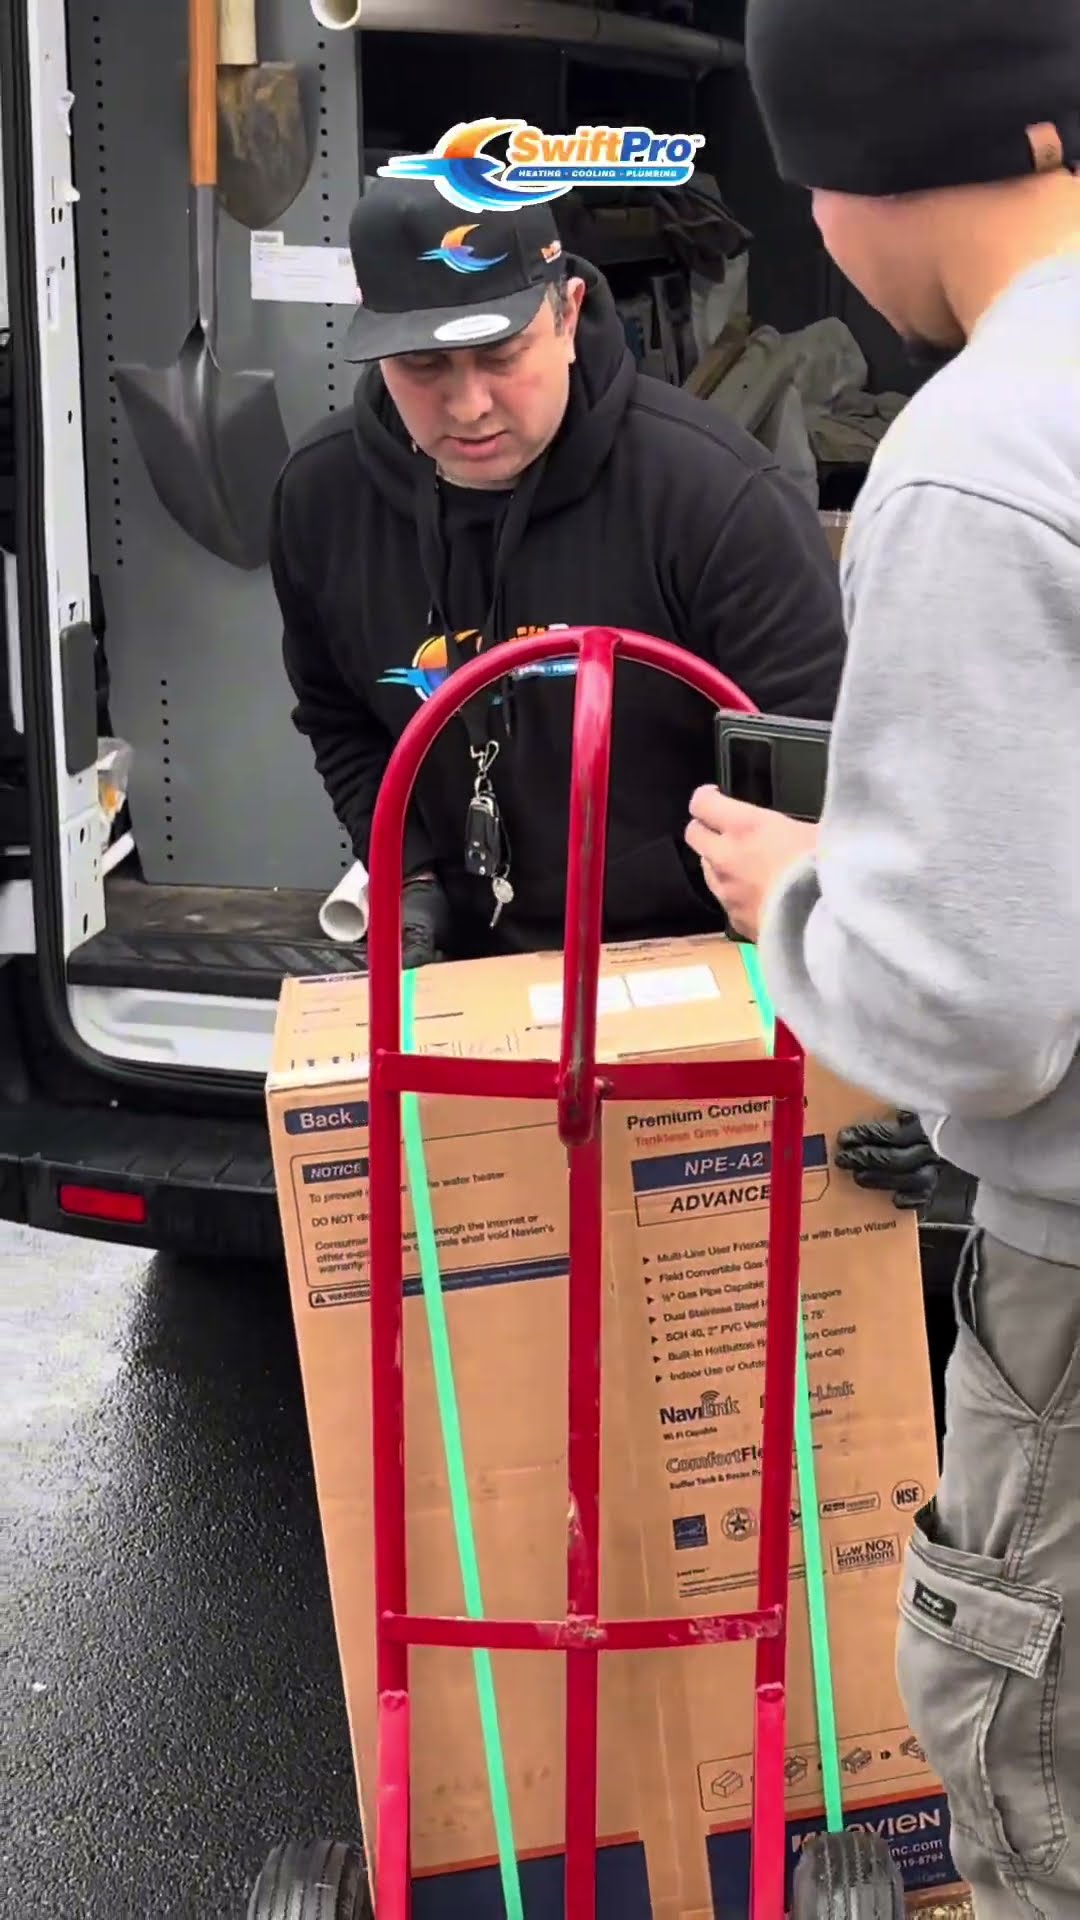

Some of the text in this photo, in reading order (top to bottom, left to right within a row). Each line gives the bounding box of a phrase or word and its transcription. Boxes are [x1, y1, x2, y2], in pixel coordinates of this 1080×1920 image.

[299, 1110, 352, 1130] Back
[627, 1107, 703, 1131] Premium
[635, 1131, 690, 1148] Tankless
[694, 1128, 719, 1140] Gas
[721, 1121, 759, 1136] Water
[310, 1163, 361, 1179] NOTICE
[684, 1151, 764, 1177] NPE-A2
[309, 1193, 321, 1204] To
[324, 1189, 363, 1203] prevent
[442, 1176, 470, 1187] water
[472, 1172, 505, 1183] heater
[670, 1184, 771, 1214] ADVANCE
[311, 1216, 328, 1228] DO
[331, 1214, 354, 1225] NOT
[433, 1223, 465, 1236] rough
[467, 1221, 485, 1231] the
[486, 1215, 525, 1229] internet
[527, 1215, 539, 1223] or
[316, 1251, 344, 1264] other
[461, 1232, 485, 1245] shall
[487, 1229, 509, 1241] void
[511, 1224, 555, 1238] Navien's
[657, 1248, 706, 1263] Multi-Line
[707, 1245, 731, 1256] User
[811, 1230, 832, 1241] with
[833, 1224, 863, 1238] Setup
[864, 1219, 897, 1233] Wizard
[659, 1260, 763, 1283] Field Convertible Gas
[677, 1290, 698, 1301] Gas
[699, 1286, 722, 1297] Pipe
[663, 1311, 686, 1323] Dual
[688, 1304, 733, 1319] Stainless
[665, 1330, 689, 1342] SCH
[720, 1322, 742, 1335] PVC
[821, 1324, 857, 1338] Control
[669, 1368, 702, 1381] Indoor
[703, 1366, 723, 1377] Use
[725, 1364, 735, 1373] or
[896, 1486, 920, 1505] NSF
[864, 1538, 894, 1553] NOx
[837, 1549, 895, 1568] emissions
